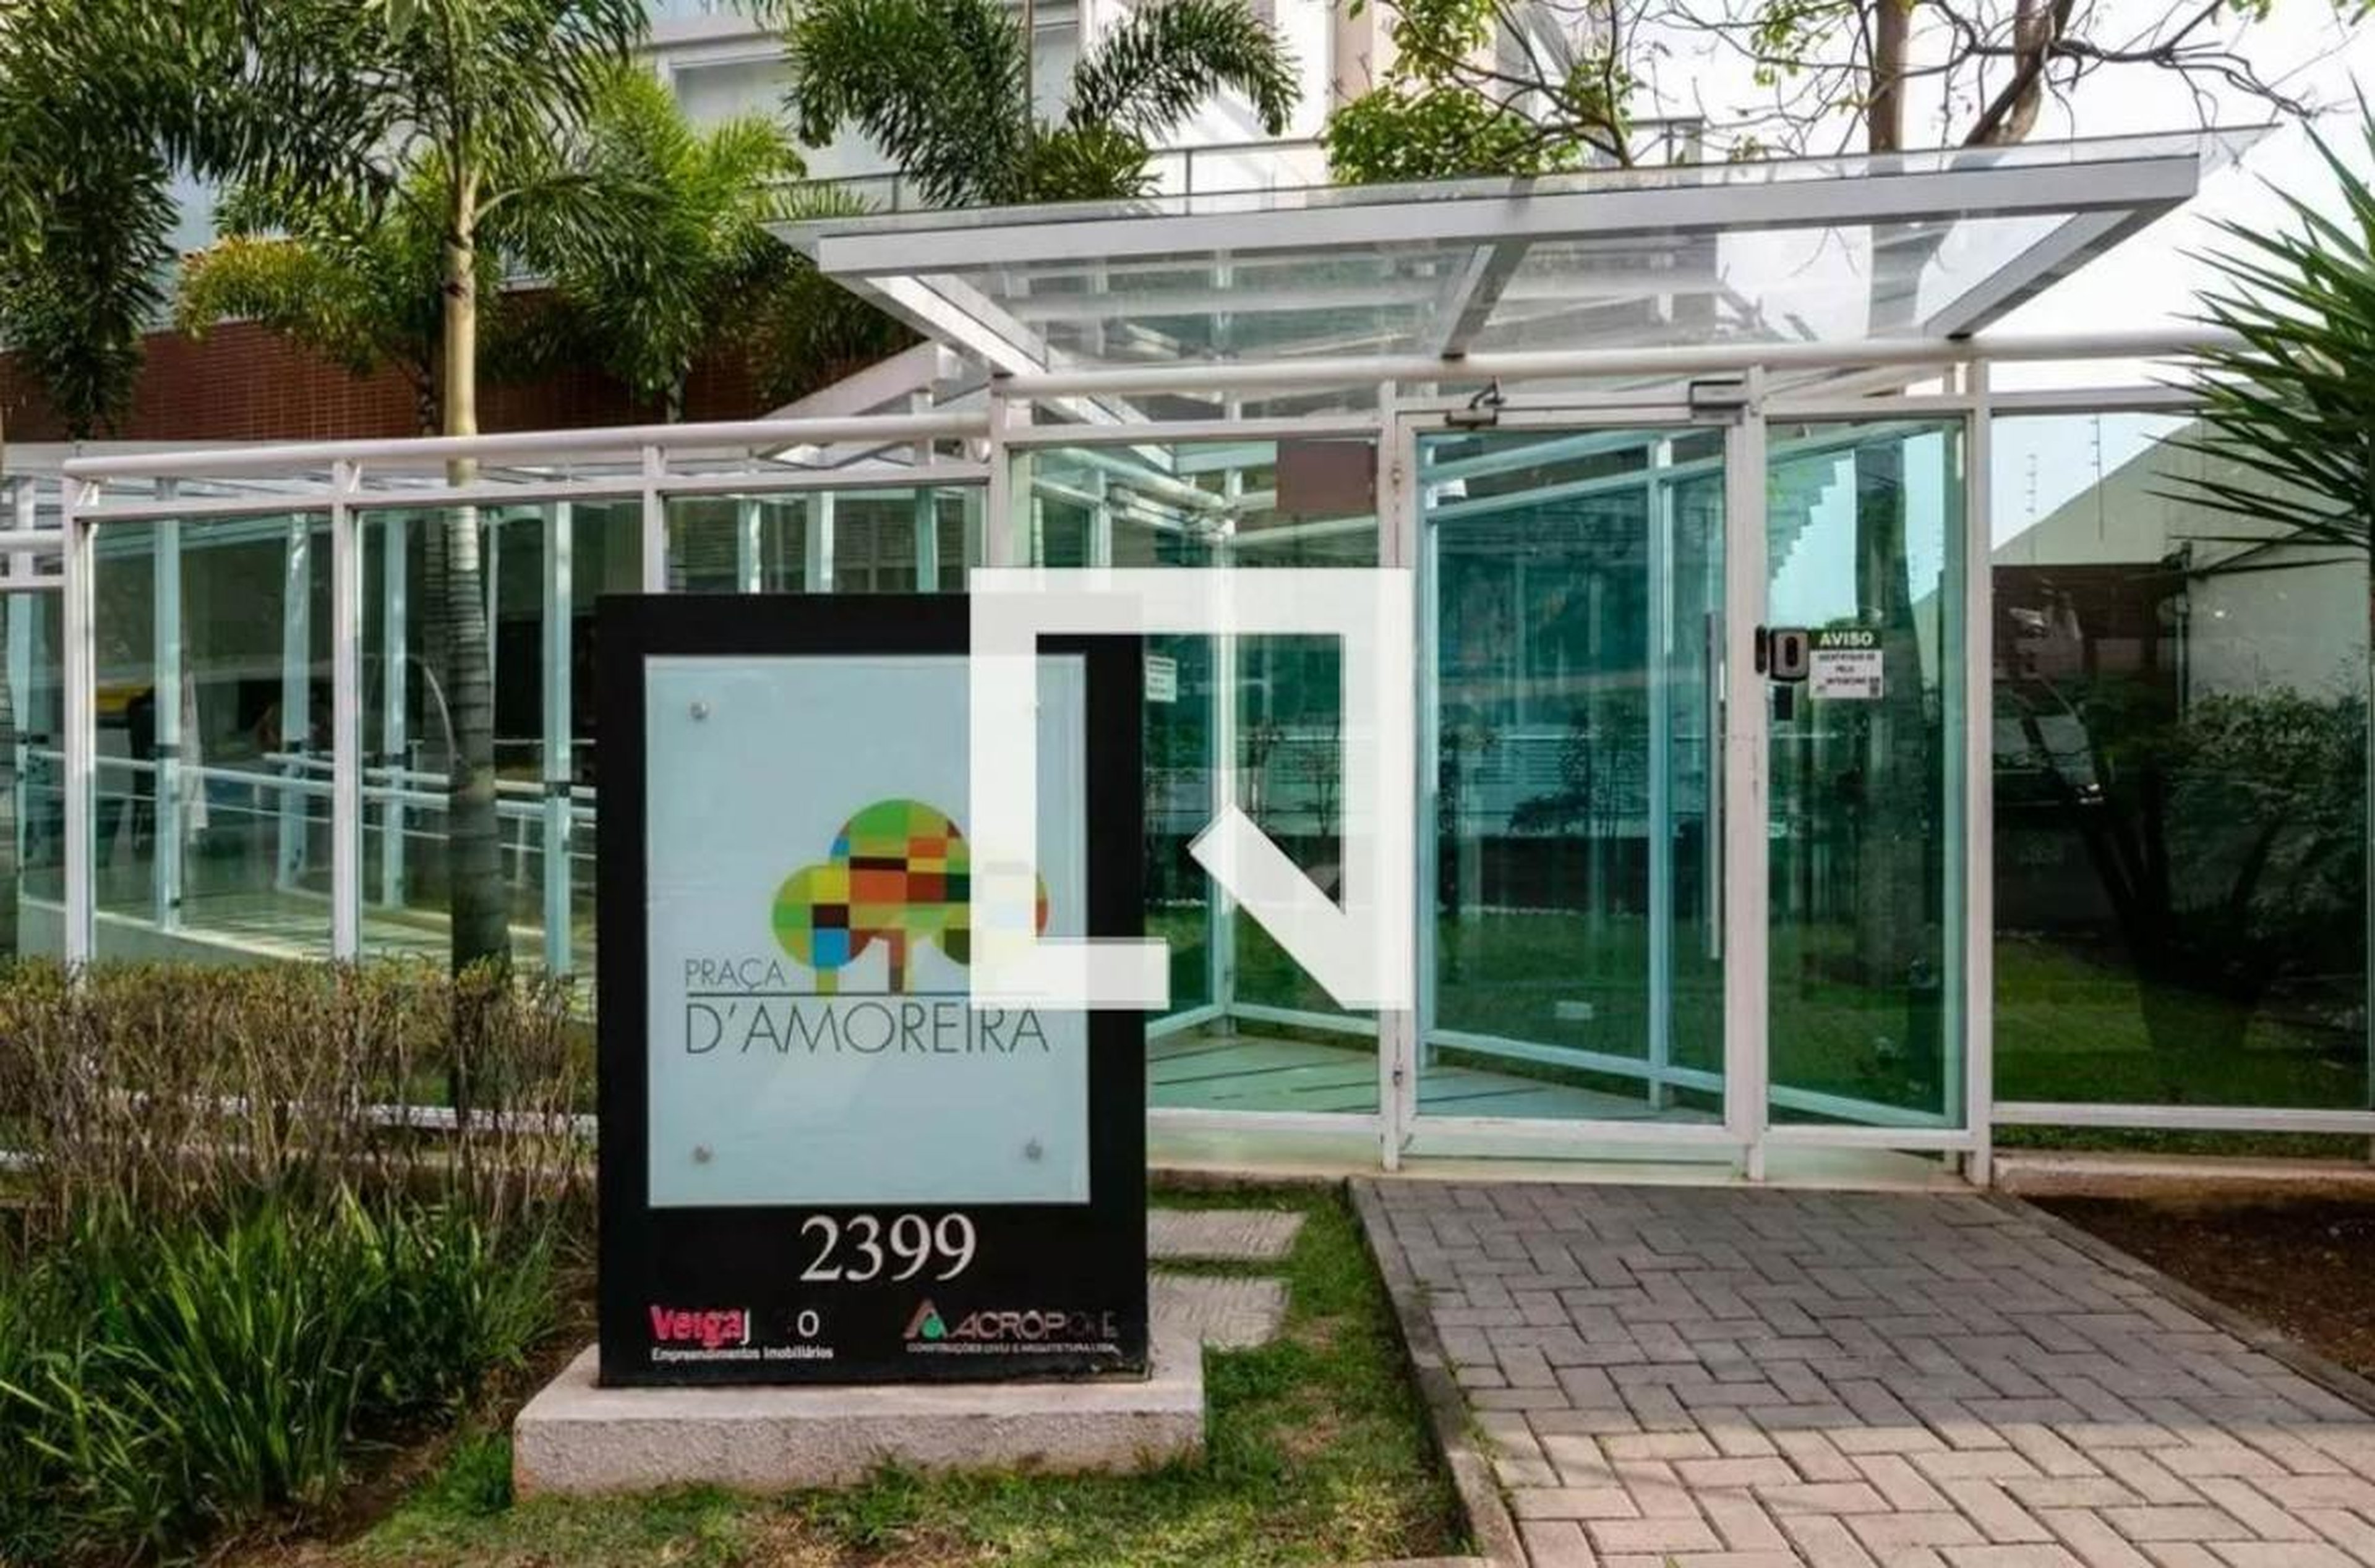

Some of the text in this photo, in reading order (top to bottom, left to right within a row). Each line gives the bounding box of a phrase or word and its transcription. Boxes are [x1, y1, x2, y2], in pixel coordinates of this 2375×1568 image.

[1820, 631, 1874, 647] AVISO
[685, 958, 785, 991] PRAÇA
[800, 1212, 976, 1282] 2399
